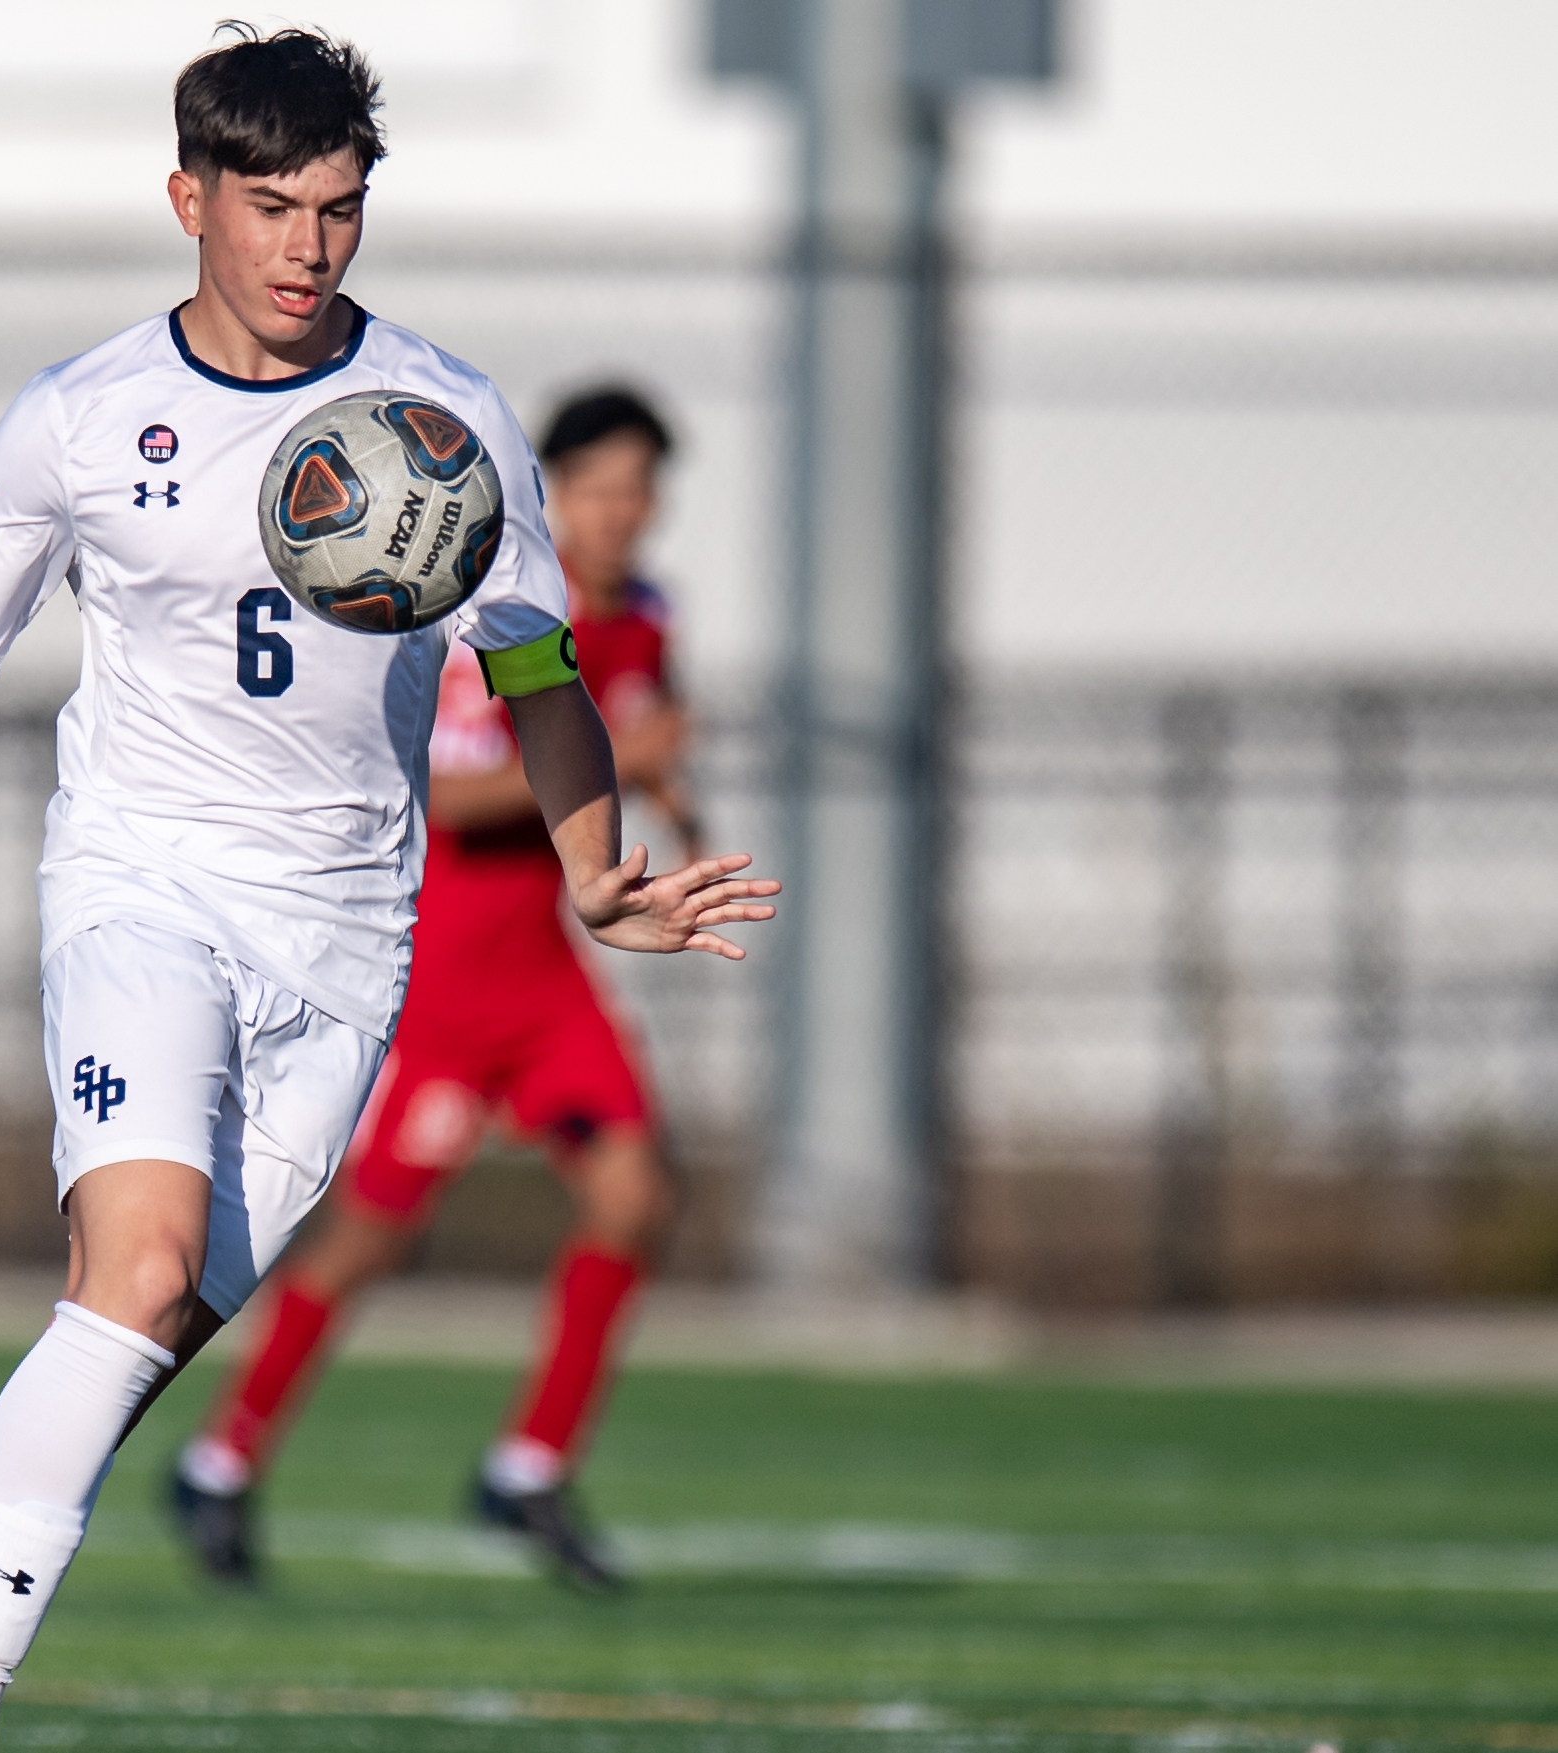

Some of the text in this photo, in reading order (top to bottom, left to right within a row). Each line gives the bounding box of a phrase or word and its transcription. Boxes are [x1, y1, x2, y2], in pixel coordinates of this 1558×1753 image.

[384, 489, 425, 559] NCAA
[417, 501, 463, 577] Wilson
[236, 587, 294, 698] 6
